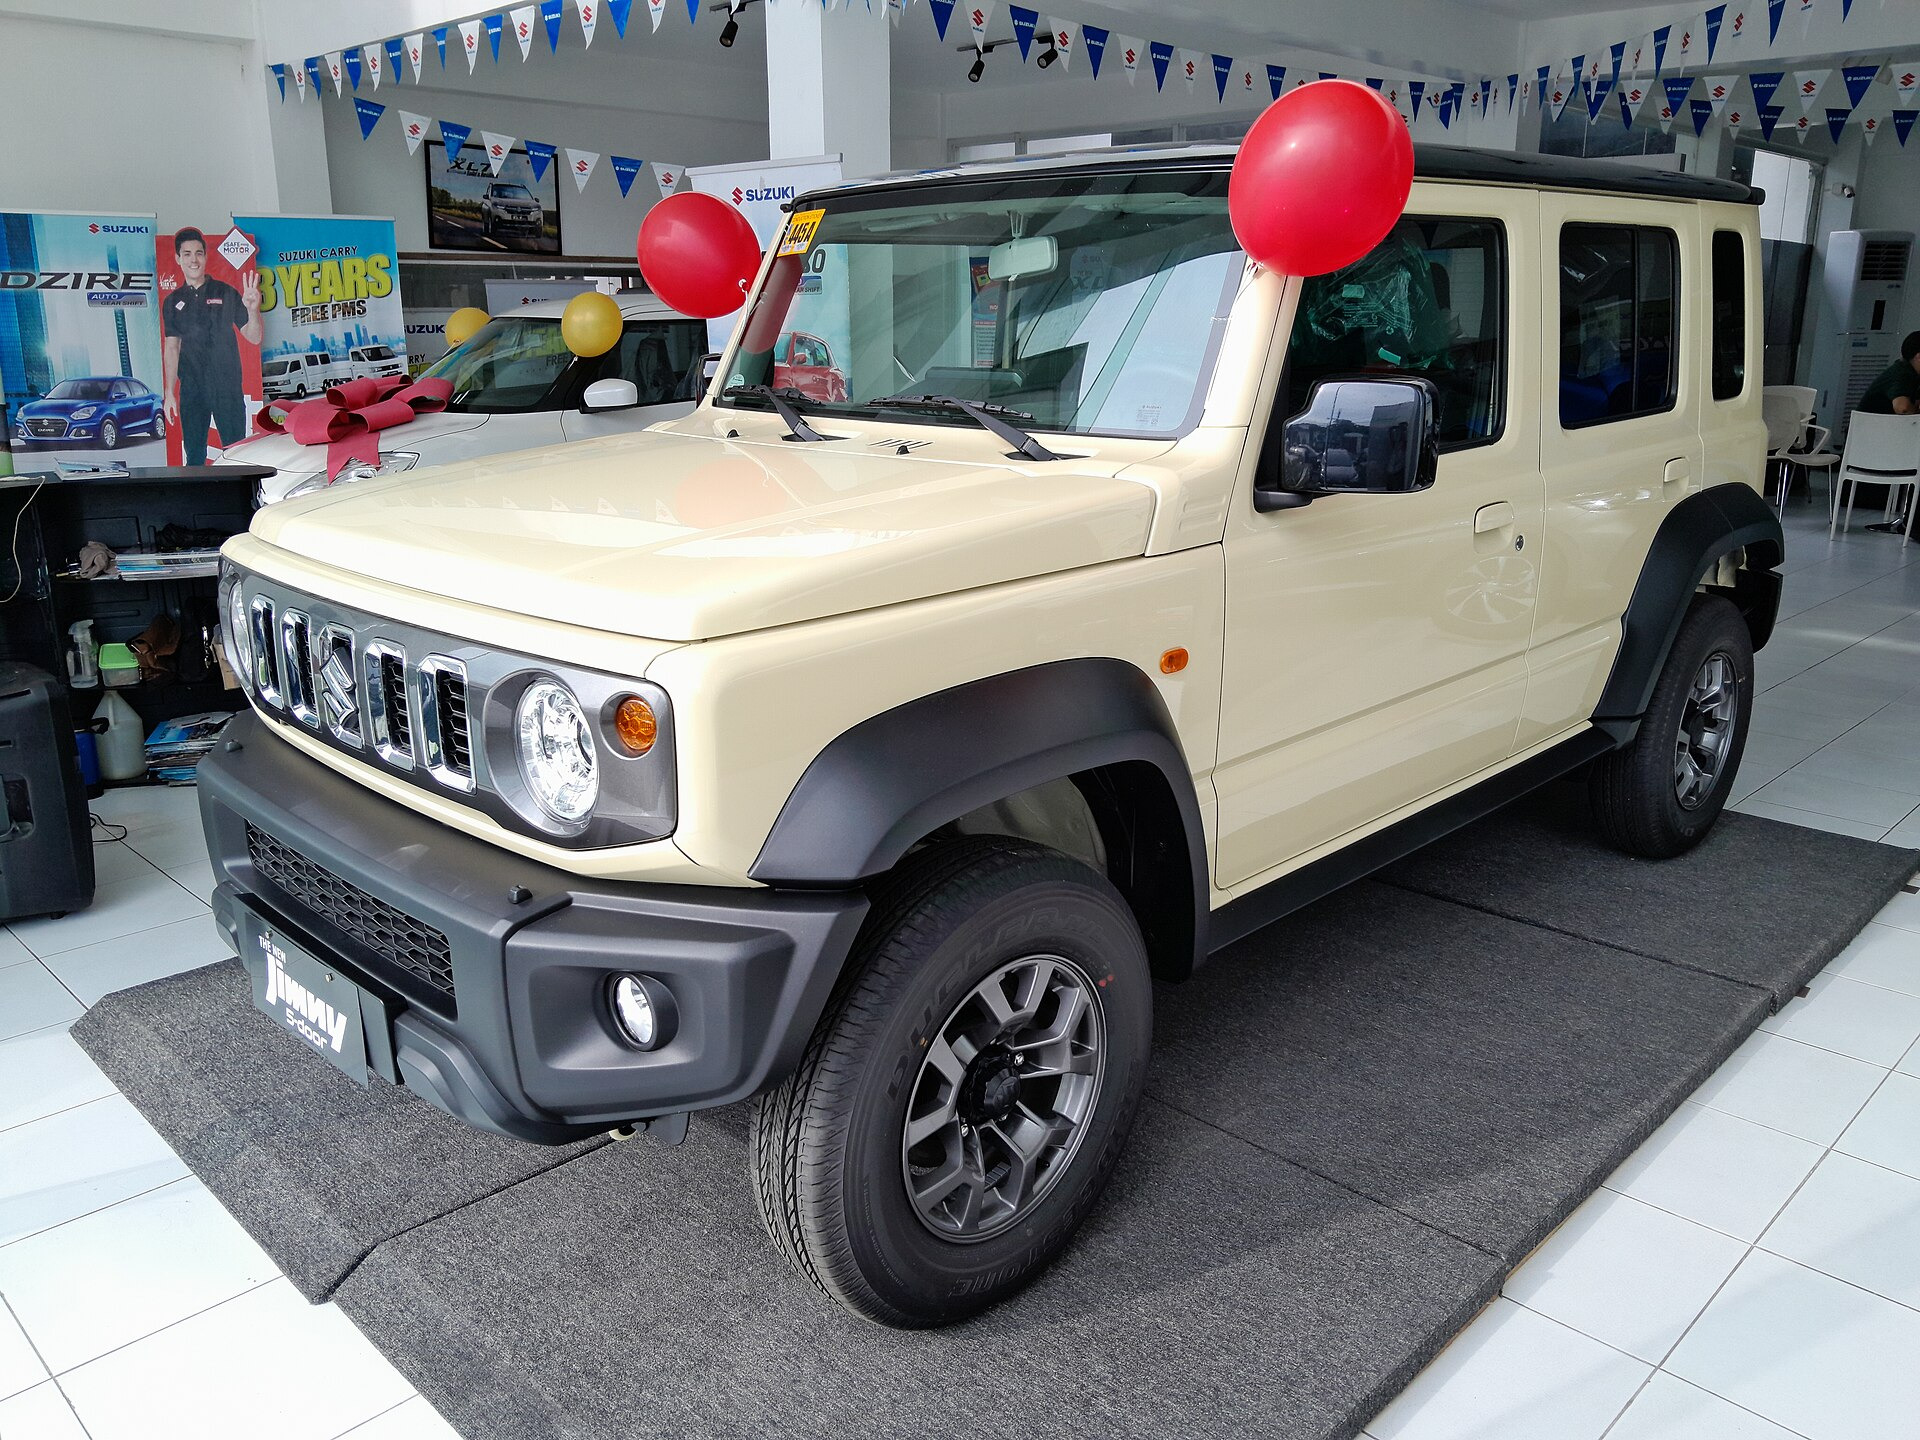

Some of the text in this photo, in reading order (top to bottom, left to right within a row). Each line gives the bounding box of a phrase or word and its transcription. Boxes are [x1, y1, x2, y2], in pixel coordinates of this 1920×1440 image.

[450, 159, 491, 172] XL7
[745, 186, 795, 202] SUZUKI
[102, 224, 149, 234] SUZUKI
[279, 245, 358, 262] SUZUKI CARRY
[0, 272, 154, 291] DZIRE
[276, 253, 393, 309] YEARS
[291, 299, 368, 325] FREE PMS
[404, 324, 446, 334] UZUK
[408, 353, 426, 365] RRY
[258, 935, 288, 964] THE NEW
